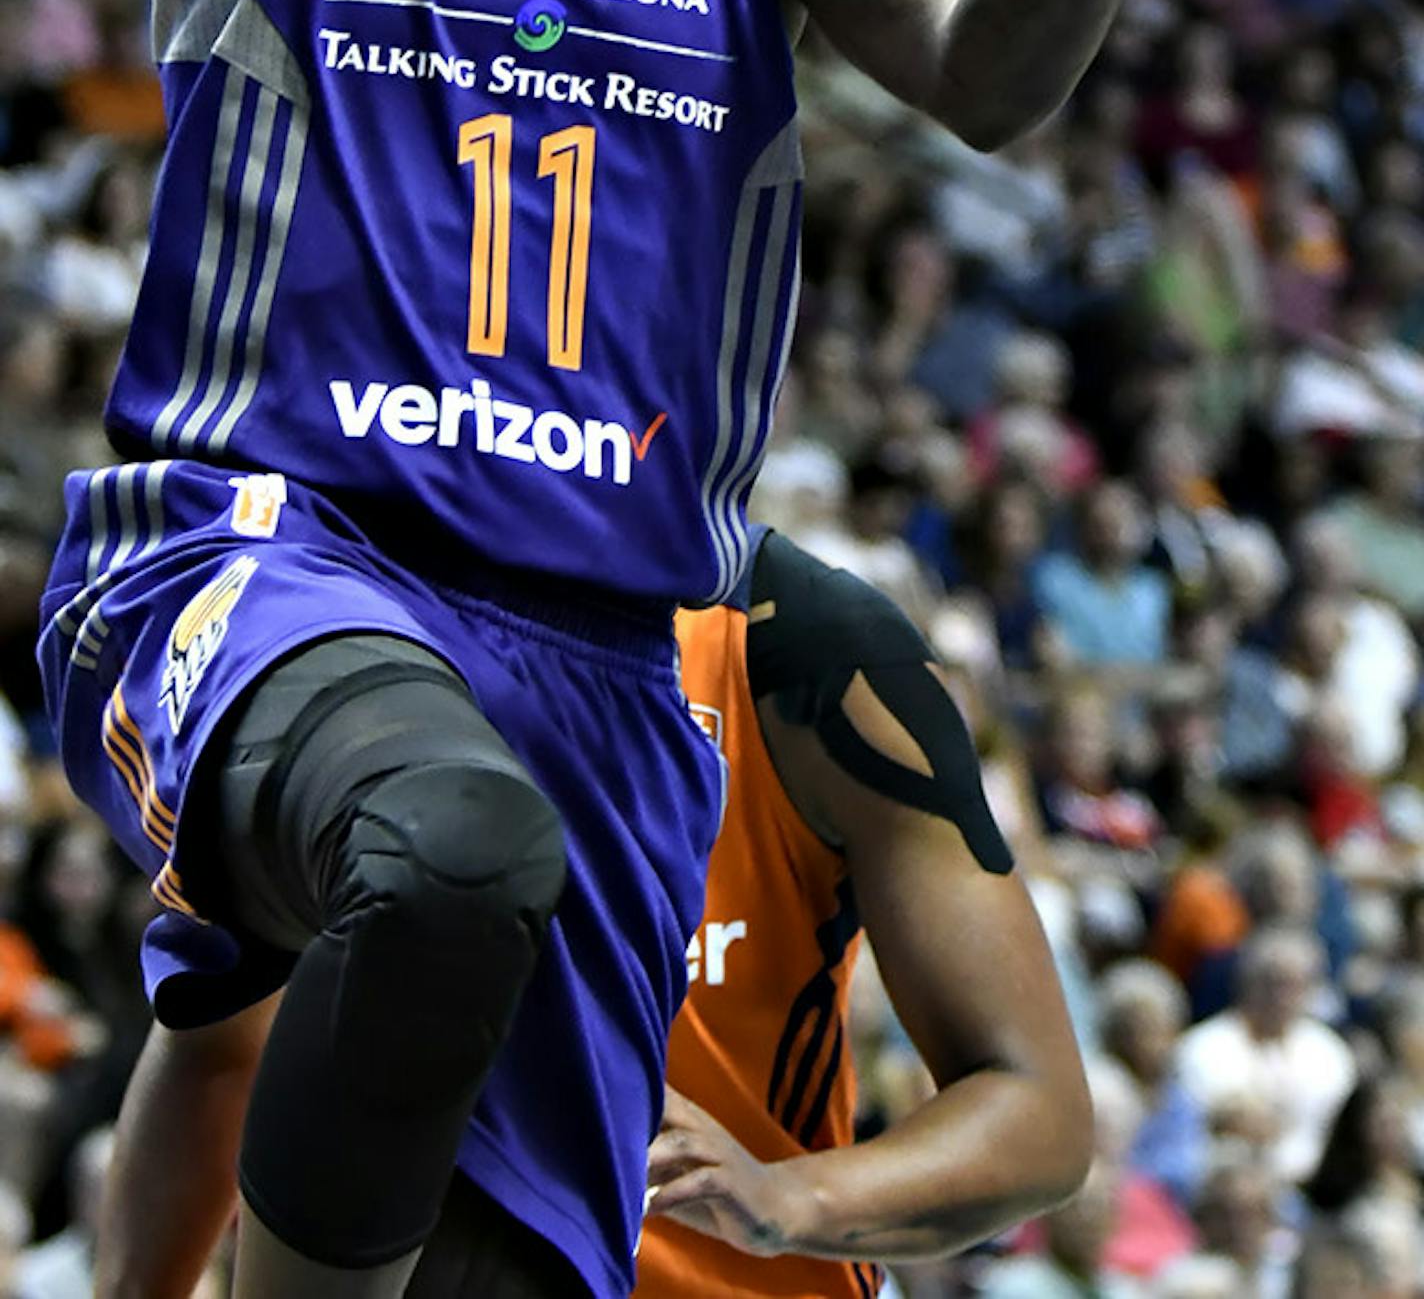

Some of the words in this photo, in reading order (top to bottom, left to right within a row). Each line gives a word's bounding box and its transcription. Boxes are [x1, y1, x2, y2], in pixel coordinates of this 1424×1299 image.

[318, 28, 477, 89] TALKING
[487, 55, 595, 107] STICK
[603, 72, 731, 133] RESORT
[457, 113, 596, 372] 11
[328, 377, 632, 485] verizon
